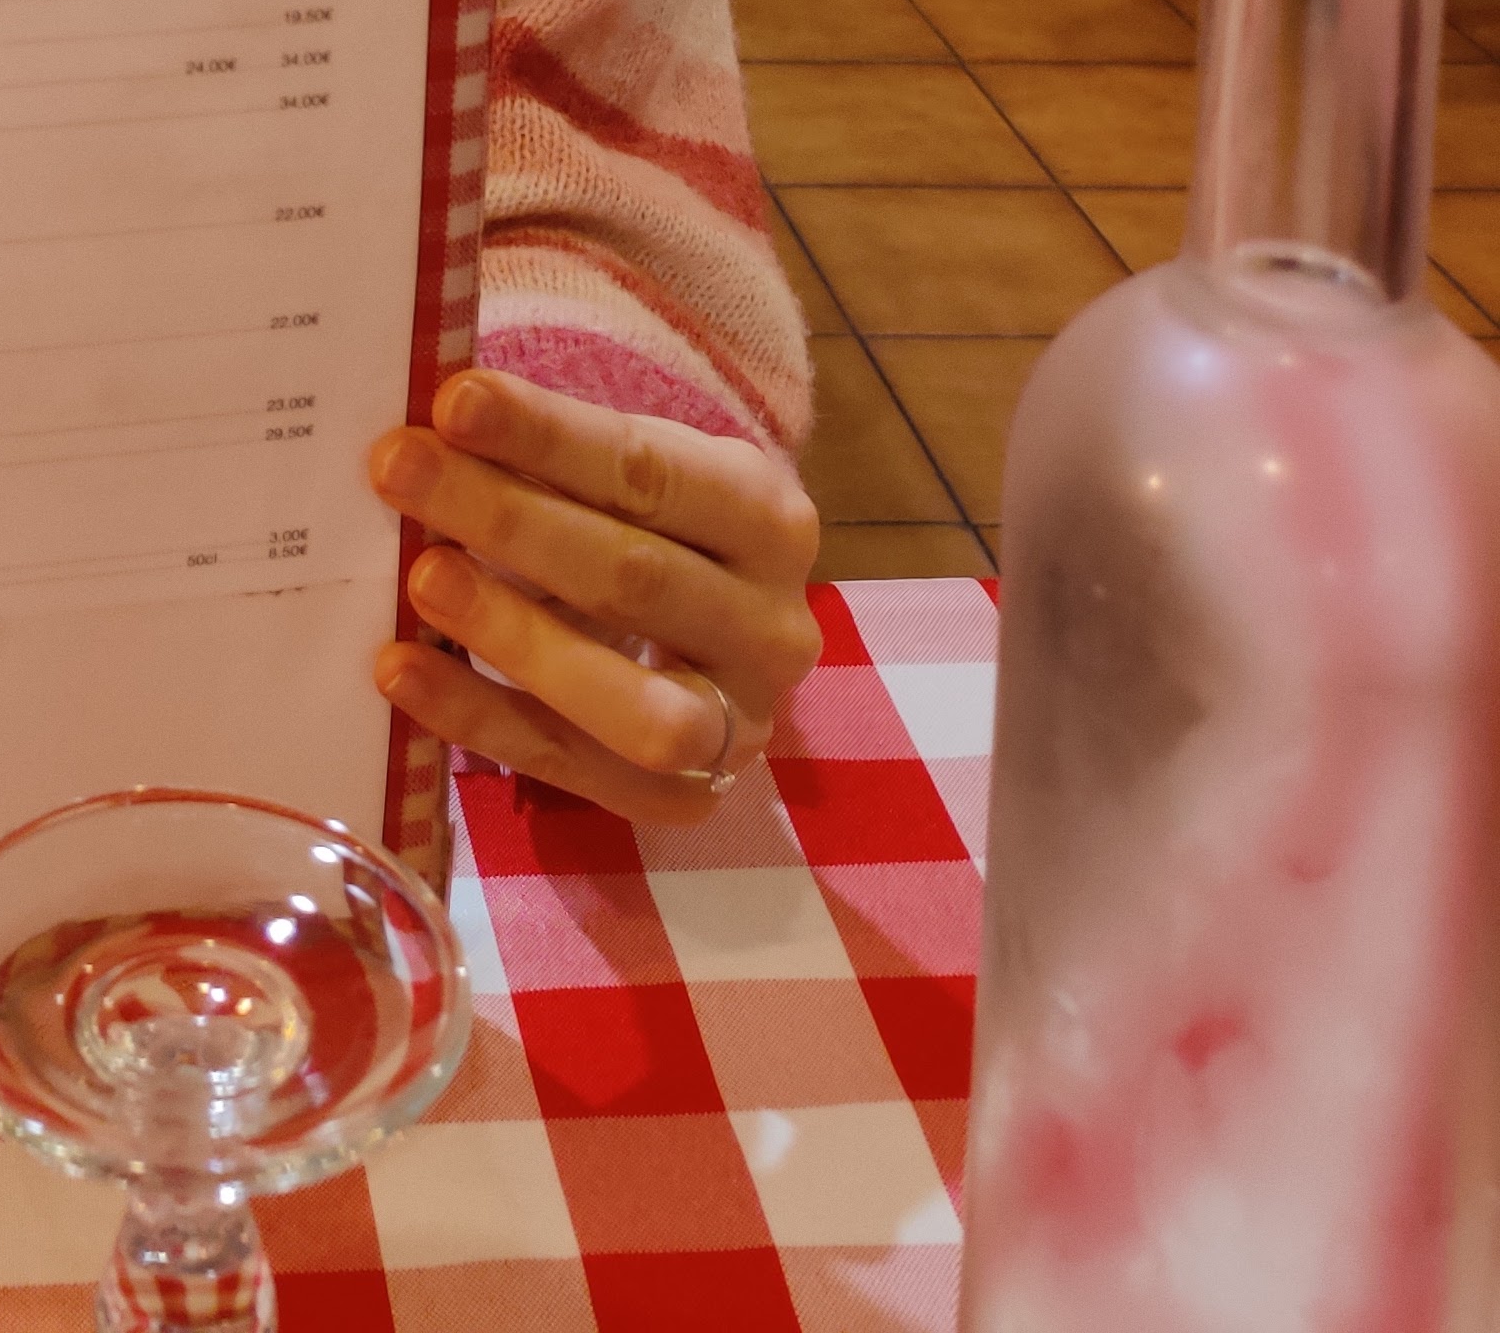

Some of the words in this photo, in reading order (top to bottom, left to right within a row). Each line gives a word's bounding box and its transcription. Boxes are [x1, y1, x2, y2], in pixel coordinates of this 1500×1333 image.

[185, 56, 238, 76] 24.00€
[280, 49, 332, 68] 34.00€
[279, 92, 330, 111] 34.00€
[269, 528, 309, 544] 3.00€
[187, 552, 218, 567] 50cl
